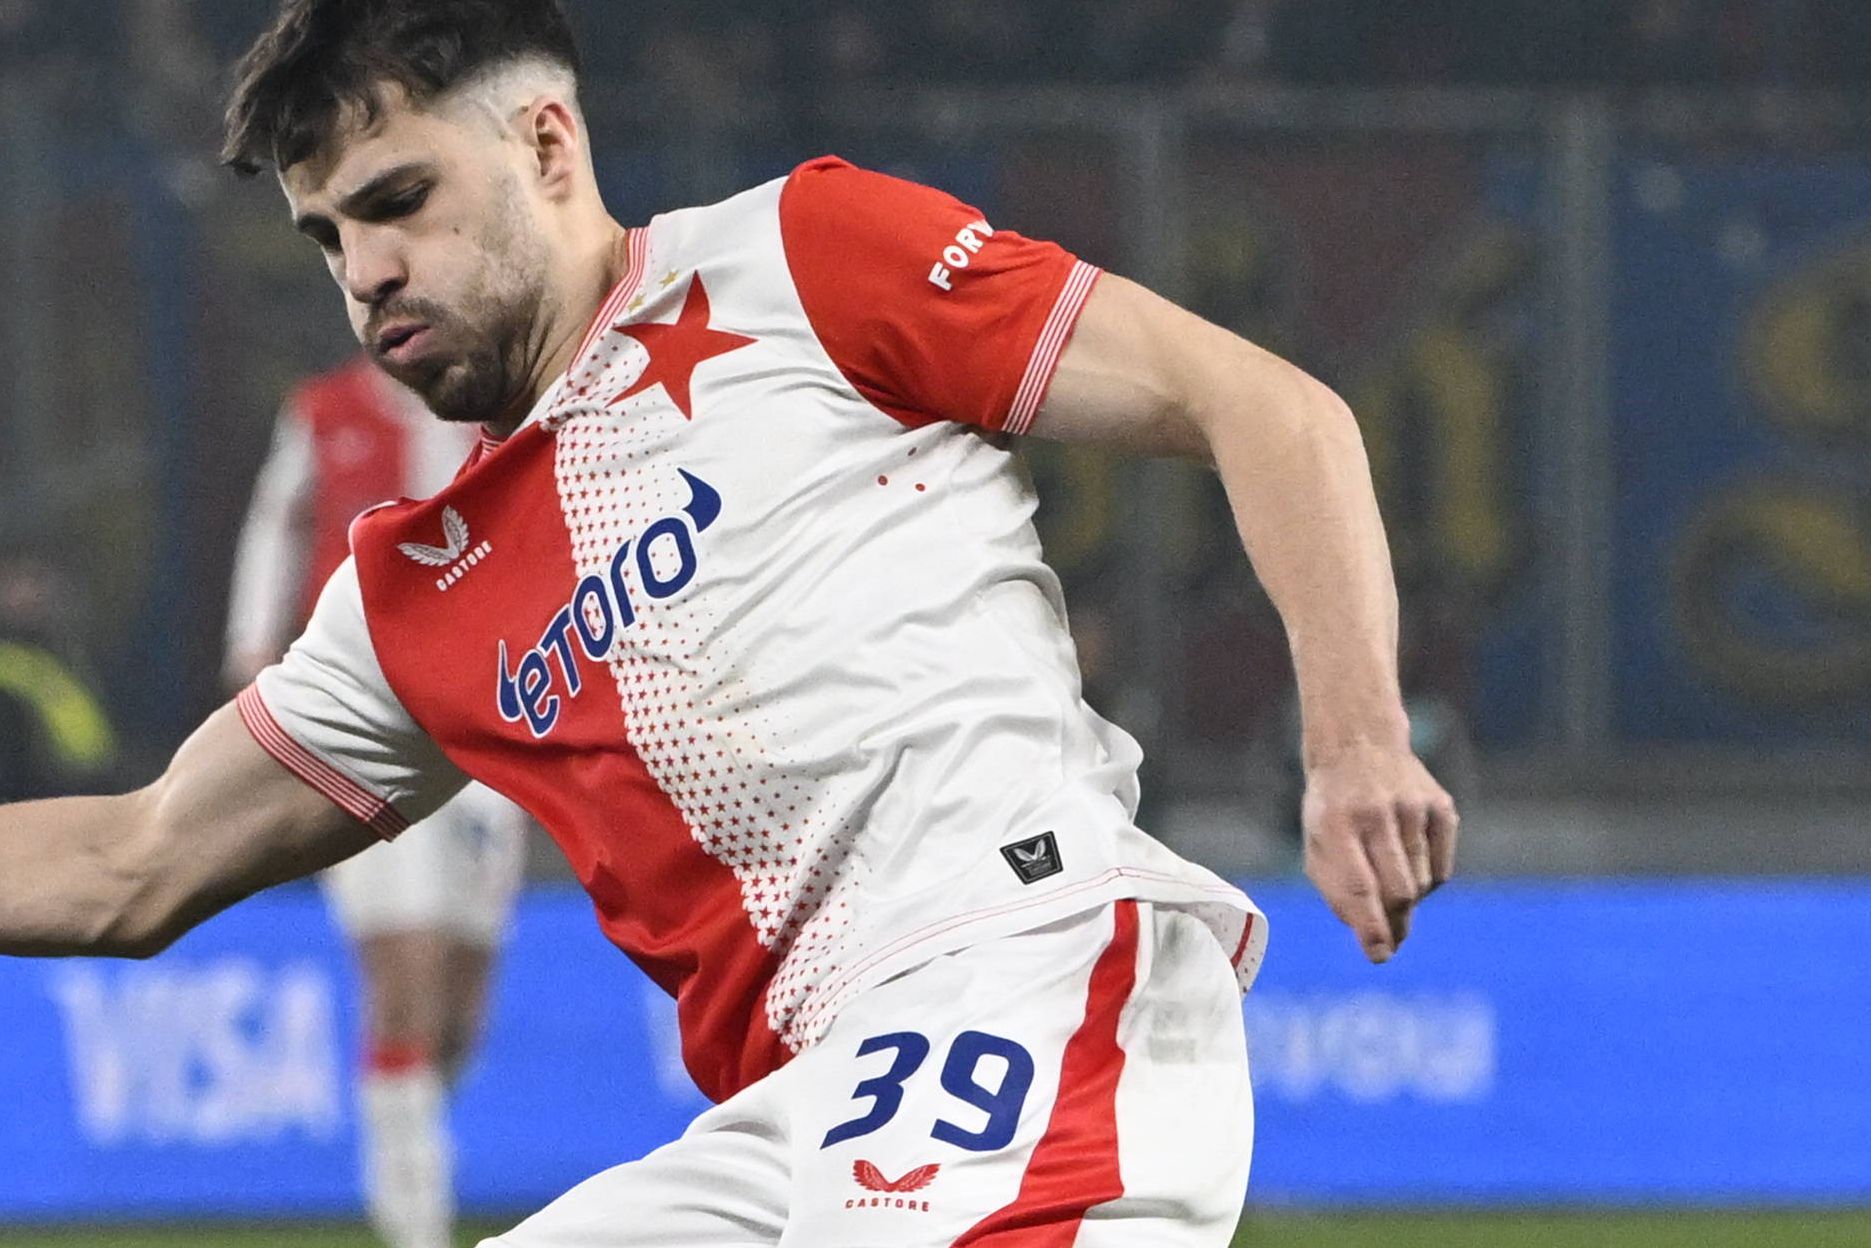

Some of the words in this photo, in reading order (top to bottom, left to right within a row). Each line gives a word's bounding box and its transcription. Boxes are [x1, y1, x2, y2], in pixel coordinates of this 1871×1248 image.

[435, 540, 493, 591] CASTORE
[49, 960, 338, 1142] VISA
[819, 1030, 1035, 1152] 39
[844, 1197, 930, 1213] CASTORE
